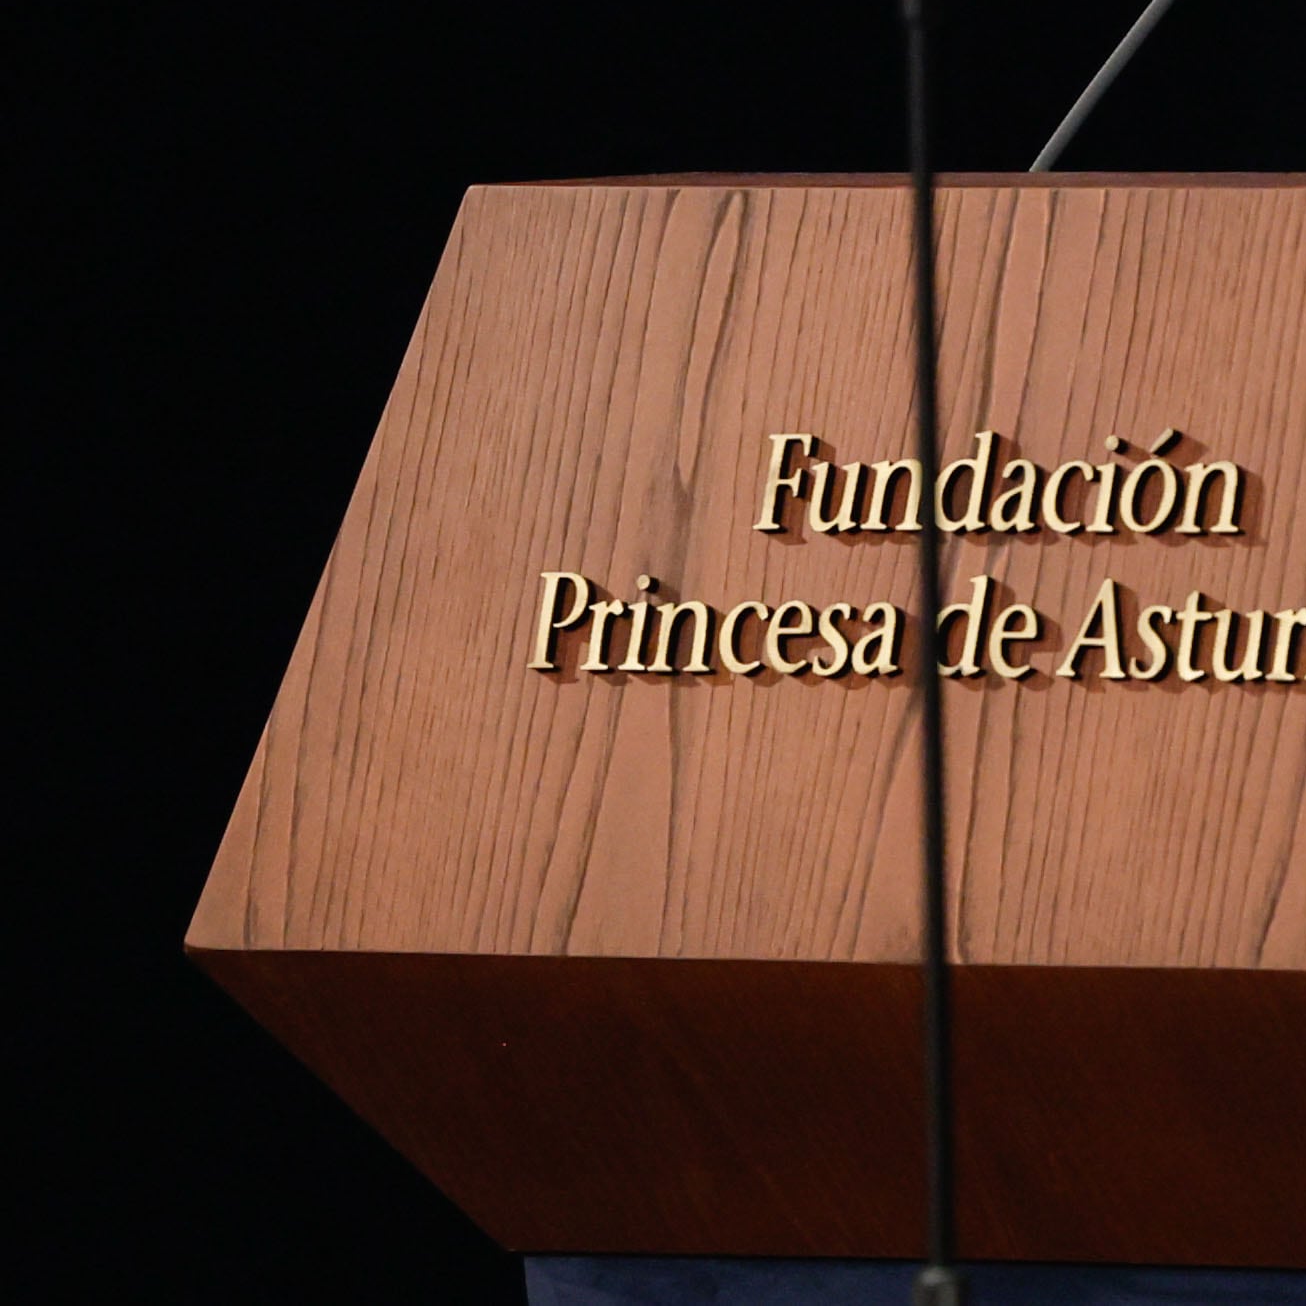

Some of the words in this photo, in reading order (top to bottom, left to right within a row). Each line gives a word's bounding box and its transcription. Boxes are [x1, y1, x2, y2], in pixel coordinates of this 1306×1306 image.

[752, 428, 1240, 535] Fundación
[528, 572, 898, 676] Princesa
[935, 575, 1038, 678] de
